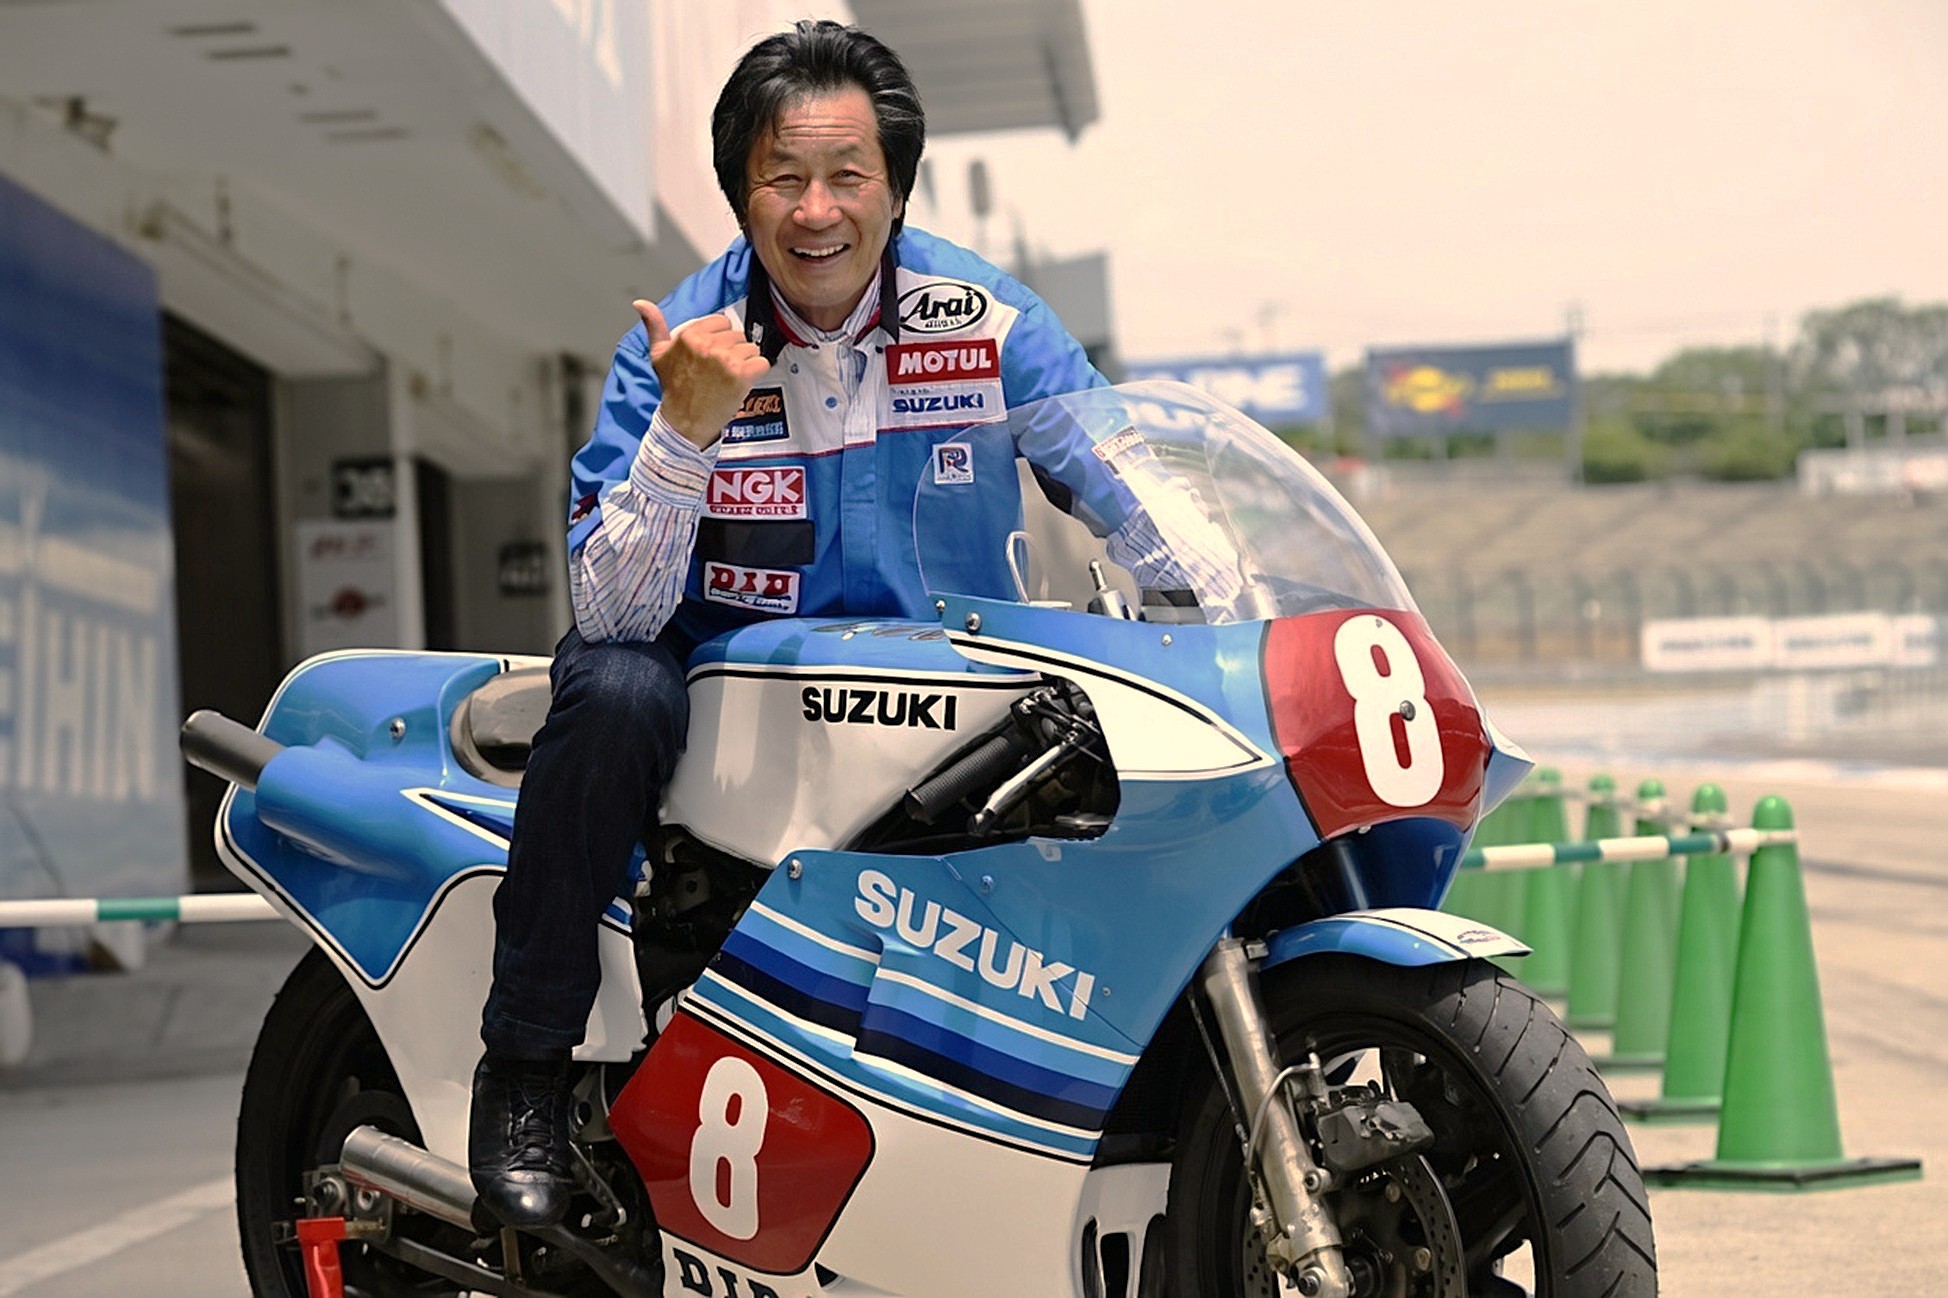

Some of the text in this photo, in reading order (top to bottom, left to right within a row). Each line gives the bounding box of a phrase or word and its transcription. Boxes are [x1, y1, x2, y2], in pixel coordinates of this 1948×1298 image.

[900, 291, 978, 322] Arai
[898, 348, 992, 375] MOTUL
[893, 393, 984, 412] SUZUKI
[713, 471, 801, 503] NGK
[802, 687, 957, 730] SUZUKI
[1334, 615, 1444, 808] 8
[855, 869, 1096, 1021] SUZUKI
[689, 1057, 768, 1240] 8
